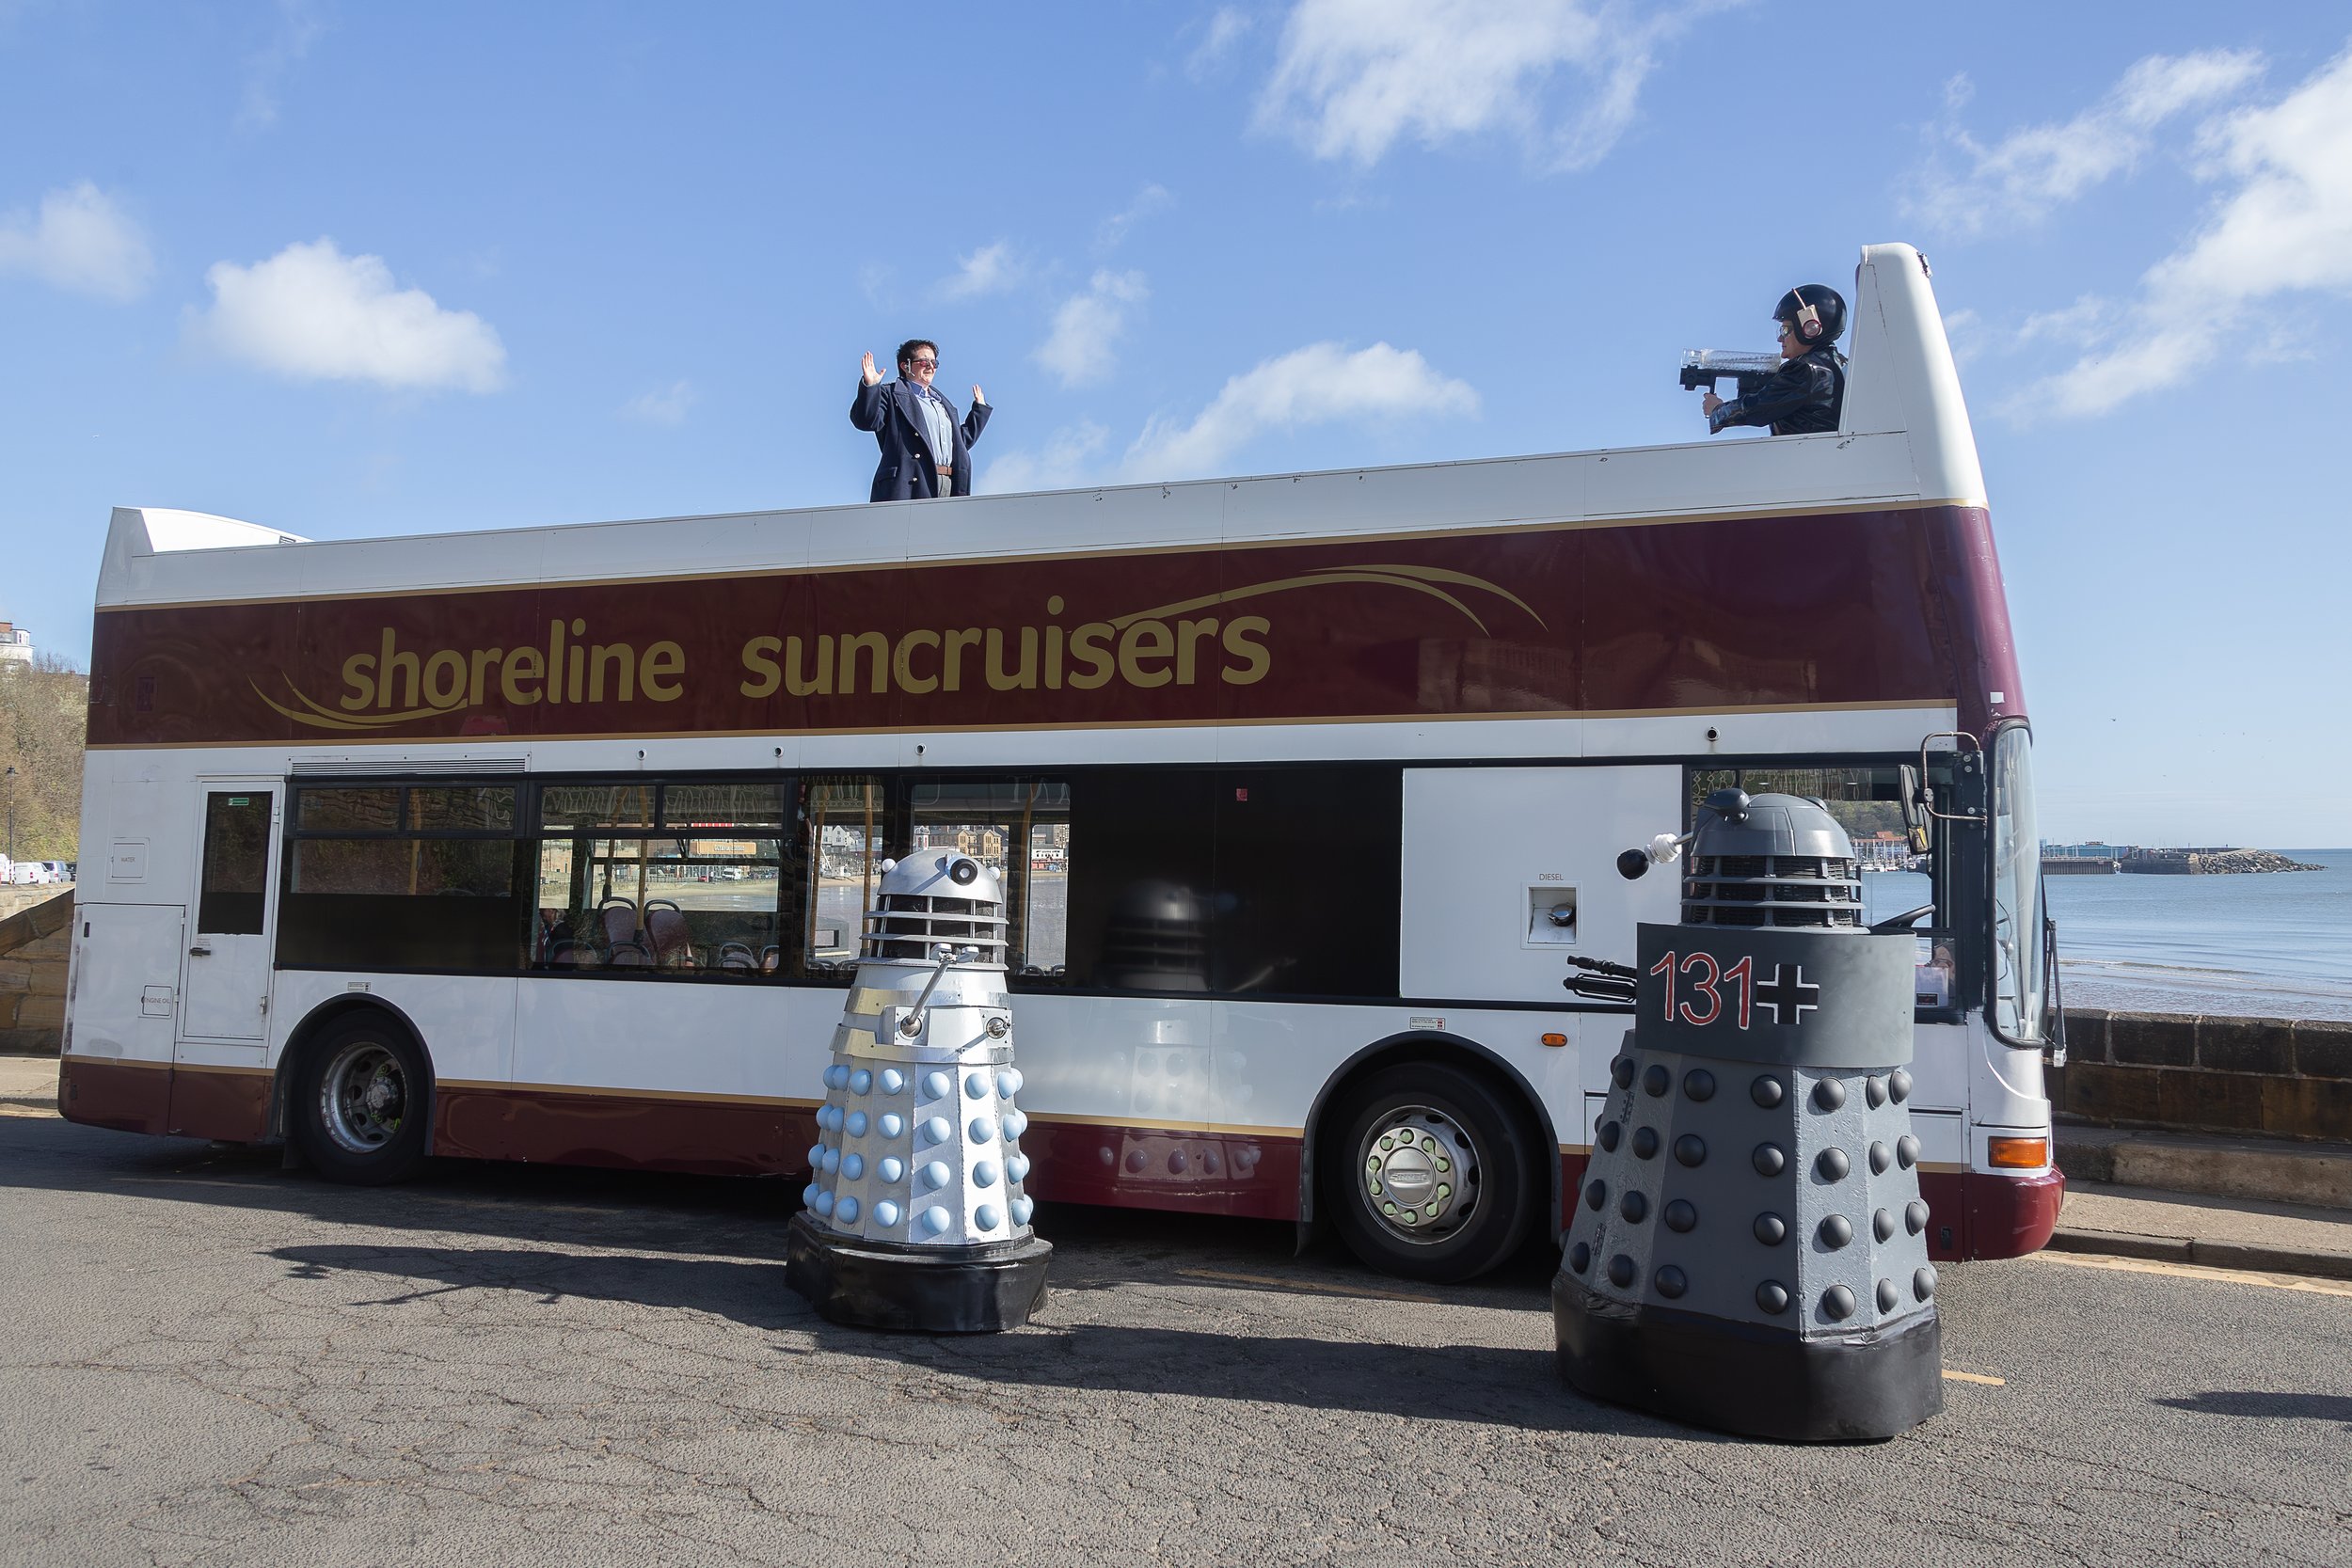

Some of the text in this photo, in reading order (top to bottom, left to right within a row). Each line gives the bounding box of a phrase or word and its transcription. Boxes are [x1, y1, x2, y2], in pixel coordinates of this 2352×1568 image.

[341, 594, 1271, 711] shoreline suncruisers
[1538, 873, 1565, 881] DIESEL
[1650, 950, 1753, 1031] 131
